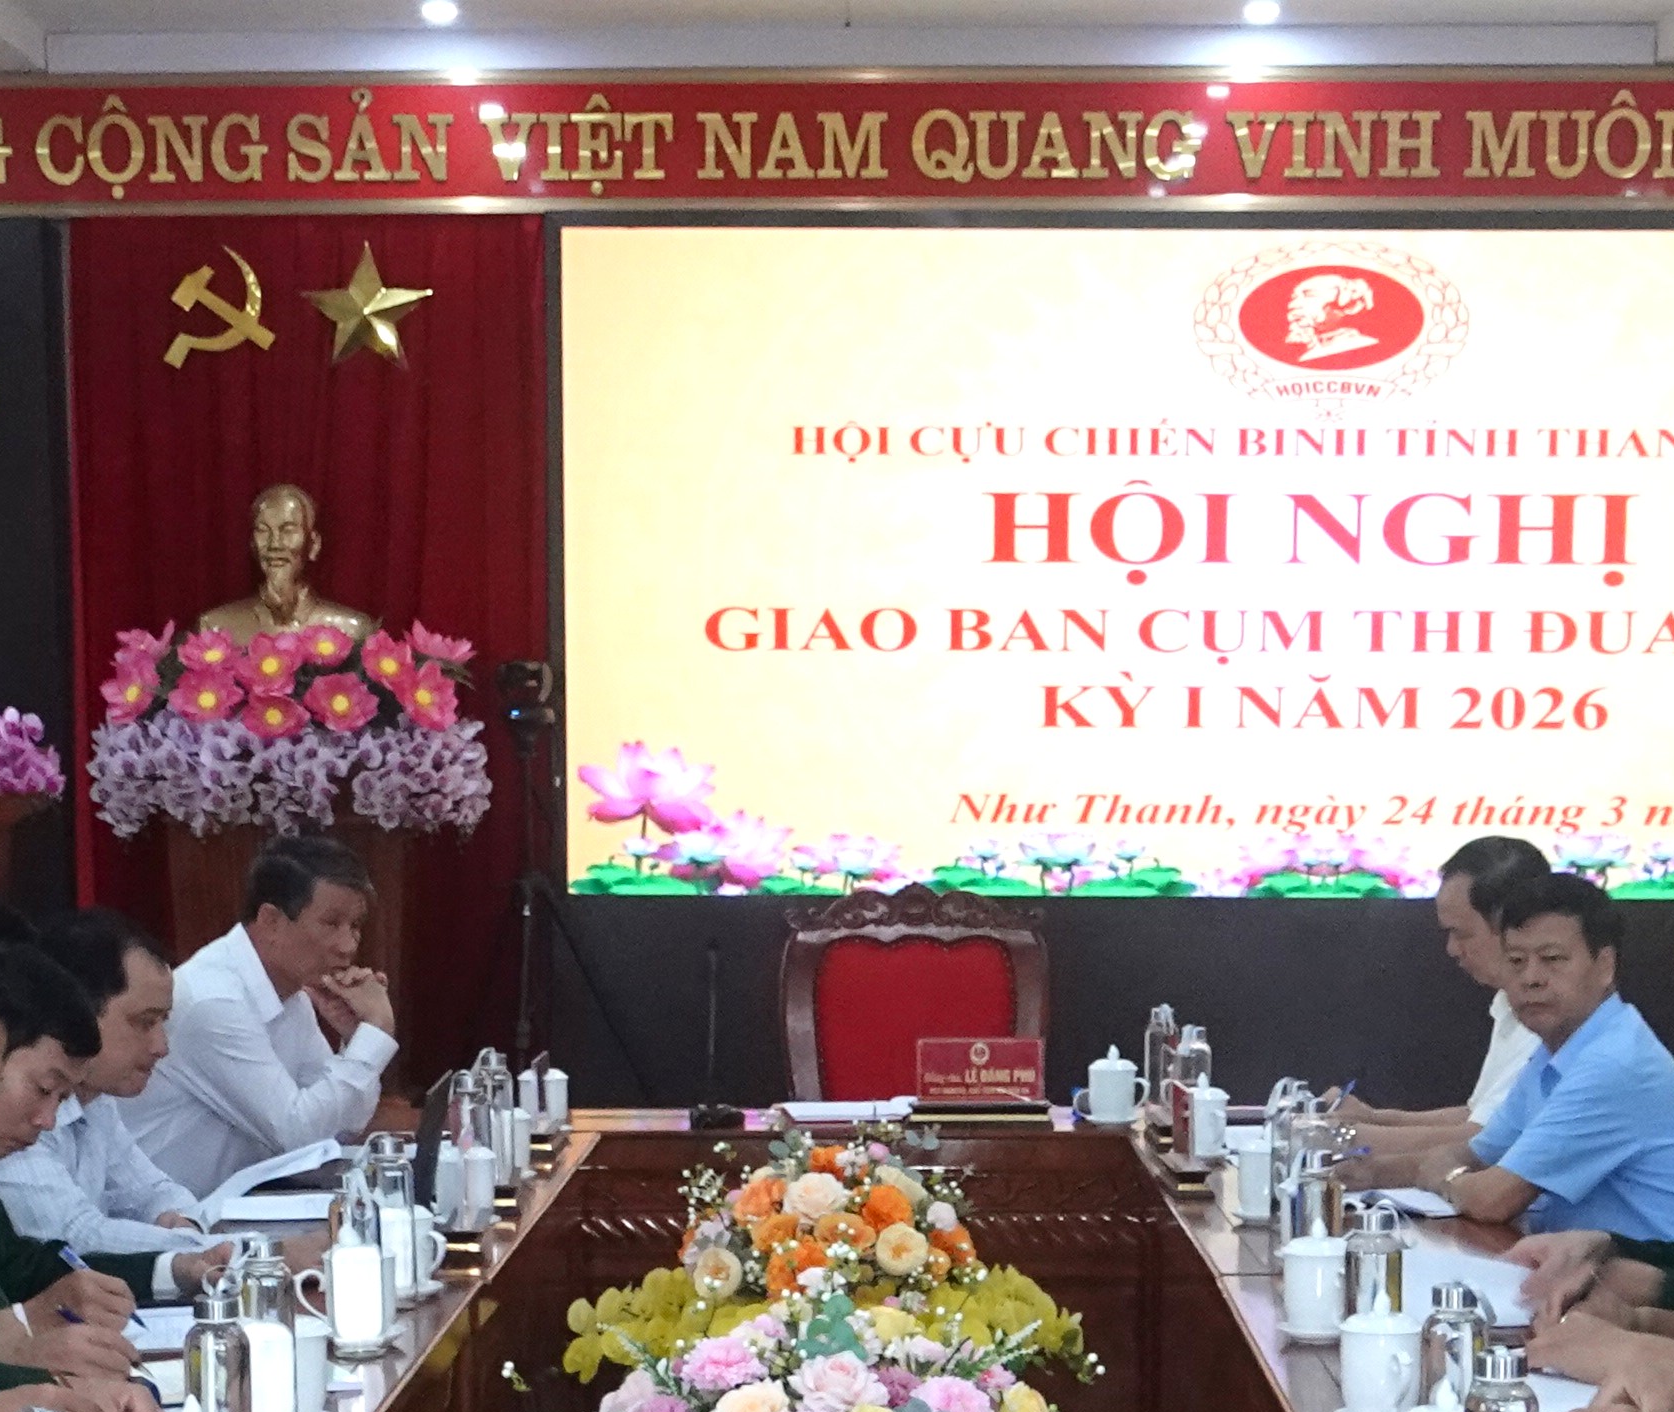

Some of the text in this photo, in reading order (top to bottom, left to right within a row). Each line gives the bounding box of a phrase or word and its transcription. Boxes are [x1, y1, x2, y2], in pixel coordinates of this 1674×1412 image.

[35, 94, 269, 200] CỘNG
[286, 88, 454, 182] SẢN
[479, 93, 674, 196] VIỆT
[696, 112, 889, 180] NAM
[911, 108, 1202, 183] QUANG
[1226, 111, 1442, 179] VINH
[791, 421, 891, 464] HỘI
[908, 420, 1026, 464] CỰU
[1238, 427, 1368, 457] BINH
[981, 479, 1639, 587] HỘI NGHỊ
[703, 606, 919, 652] GIAO
[947, 607, 1110, 652] BAN
[1137, 608, 1325, 665] CỤM
[1353, 610, 1496, 654] THI
[1041, 671, 1609, 731] KỲ I NĂM 2026
[949, 793, 1057, 825] Như
[1076, 793, 1236, 830] Thanh,
[1254, 794, 1367, 834] ngày
[1382, 795, 1438, 827] 24
[1451, 795, 1585, 834] tháng
[1600, 795, 1629, 828] 3
